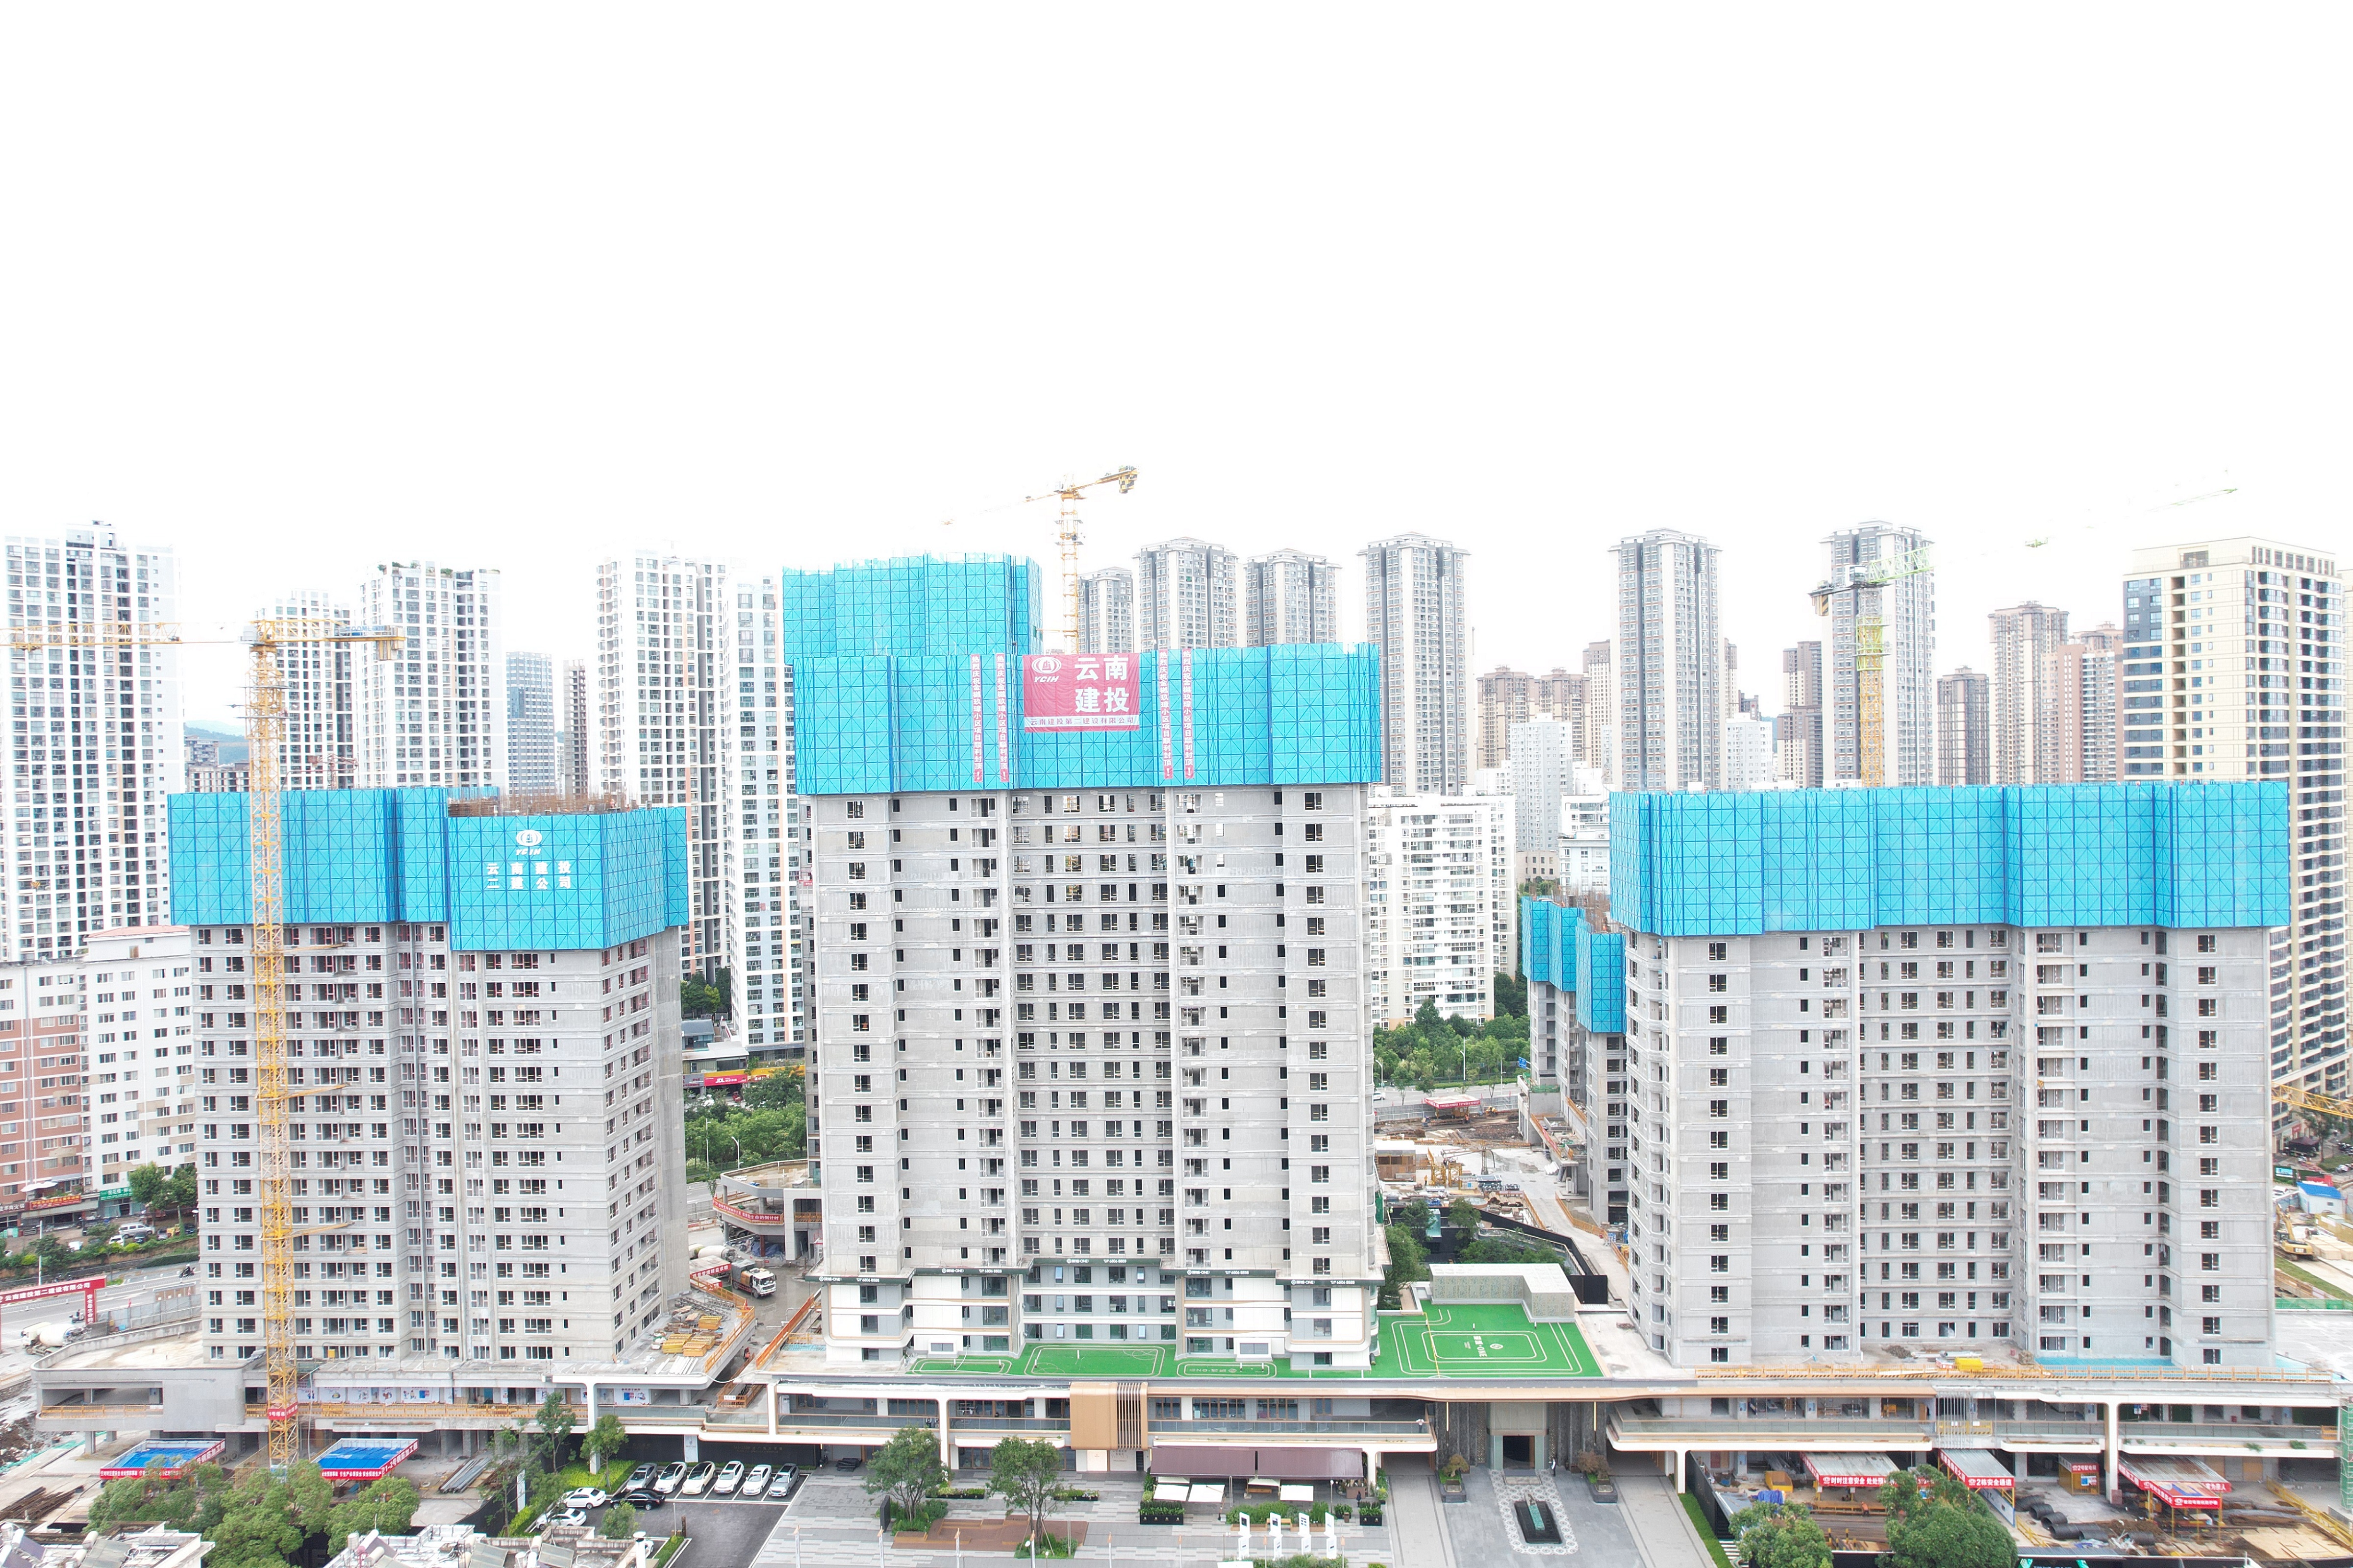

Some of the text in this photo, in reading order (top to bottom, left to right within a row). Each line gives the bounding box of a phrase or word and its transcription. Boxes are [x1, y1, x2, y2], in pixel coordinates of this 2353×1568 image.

[1075, 654, 1129, 681] 云南
[1075, 687, 1129, 713] 建投
[1030, 717, 1134, 726] 云南建投第二建设有限公司
[486, 861, 571, 876] 云南建投
[487, 876, 571, 890] 二建公司
[5, 1282, 91, 1301] 云南建投第二建设有限公司
[1830, 1477, 1865, 1485] 时时注意安全
